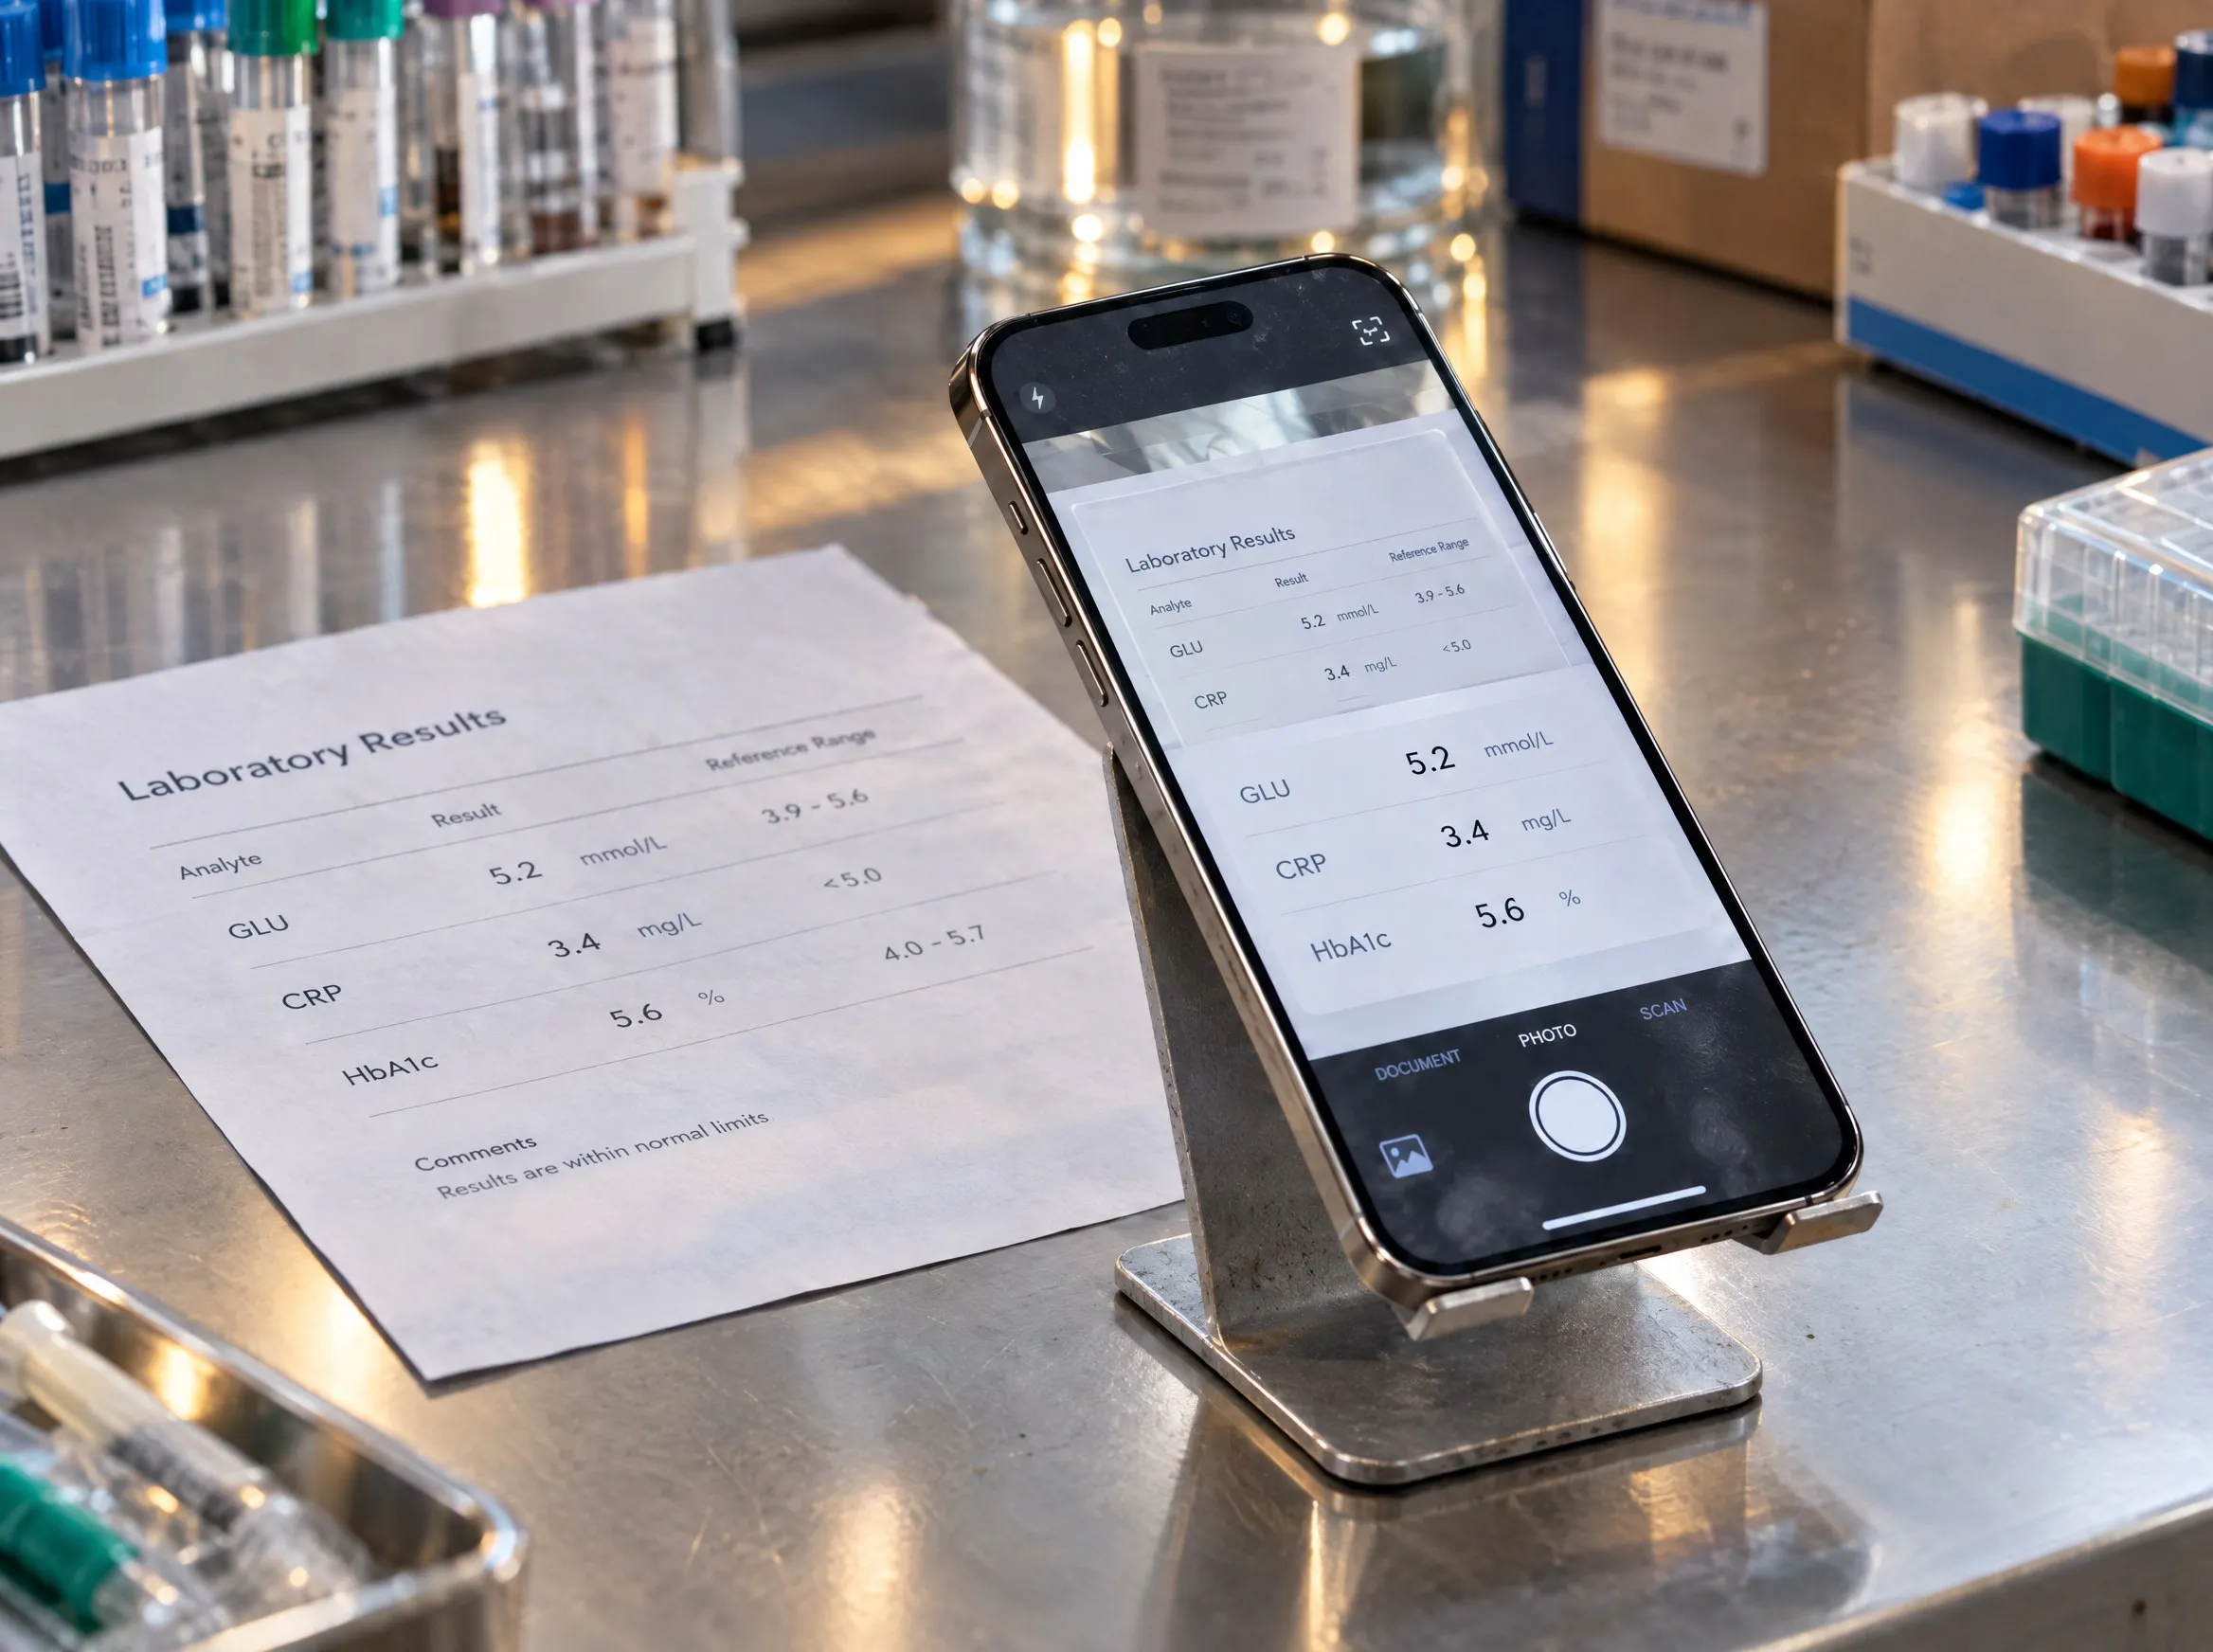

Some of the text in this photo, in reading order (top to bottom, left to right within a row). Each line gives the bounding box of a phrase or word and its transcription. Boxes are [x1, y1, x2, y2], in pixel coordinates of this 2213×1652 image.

[1124, 527, 1296, 573] Laboratory Results
[1150, 538, 1470, 616] Analyte Result Reference Range
[1169, 639, 1203, 658] GLU
[1300, 614, 1326, 630] 5.2
[1337, 603, 1379, 622] mmol/L
[1414, 589, 1434, 603] 3.9
[1445, 584, 1466, 597] 5.6
[1194, 691, 1227, 709] CRP
[1323, 664, 1350, 681] 3.4
[1364, 656, 1398, 673] mg/L
[117, 708, 507, 801] Laboratory Results
[1239, 730, 1555, 804] GLU 5.2 mmol/L
[180, 729, 876, 881] Analyte Result Reference Range
[1275, 808, 1572, 880] CRP 3.4 mg/L
[228, 914, 289, 940] GLU
[489, 861, 543, 886] 5.2
[579, 835, 668, 866] mmol/L
[761, 803, 801, 824] 3.9
[826, 788, 869, 809] 5.6
[281, 984, 342, 1010] CRP
[548, 932, 601, 958] 3.4
[637, 912, 702, 938] mg/L
[1310, 889, 1581, 962] HbA1c 5.6 %
[341, 1056, 439, 1086] HbA1c
[609, 1003, 663, 1029] 5.6
[697, 989, 726, 1006] %
[885, 941, 924, 961] 4.0
[945, 924, 984, 946] 5.7
[1374, 997, 1688, 1081] DOCUMENT PHOTO SCAN
[414, 1137, 538, 1172] Comments
[437, 1113, 769, 1199] Results are within normal limits
